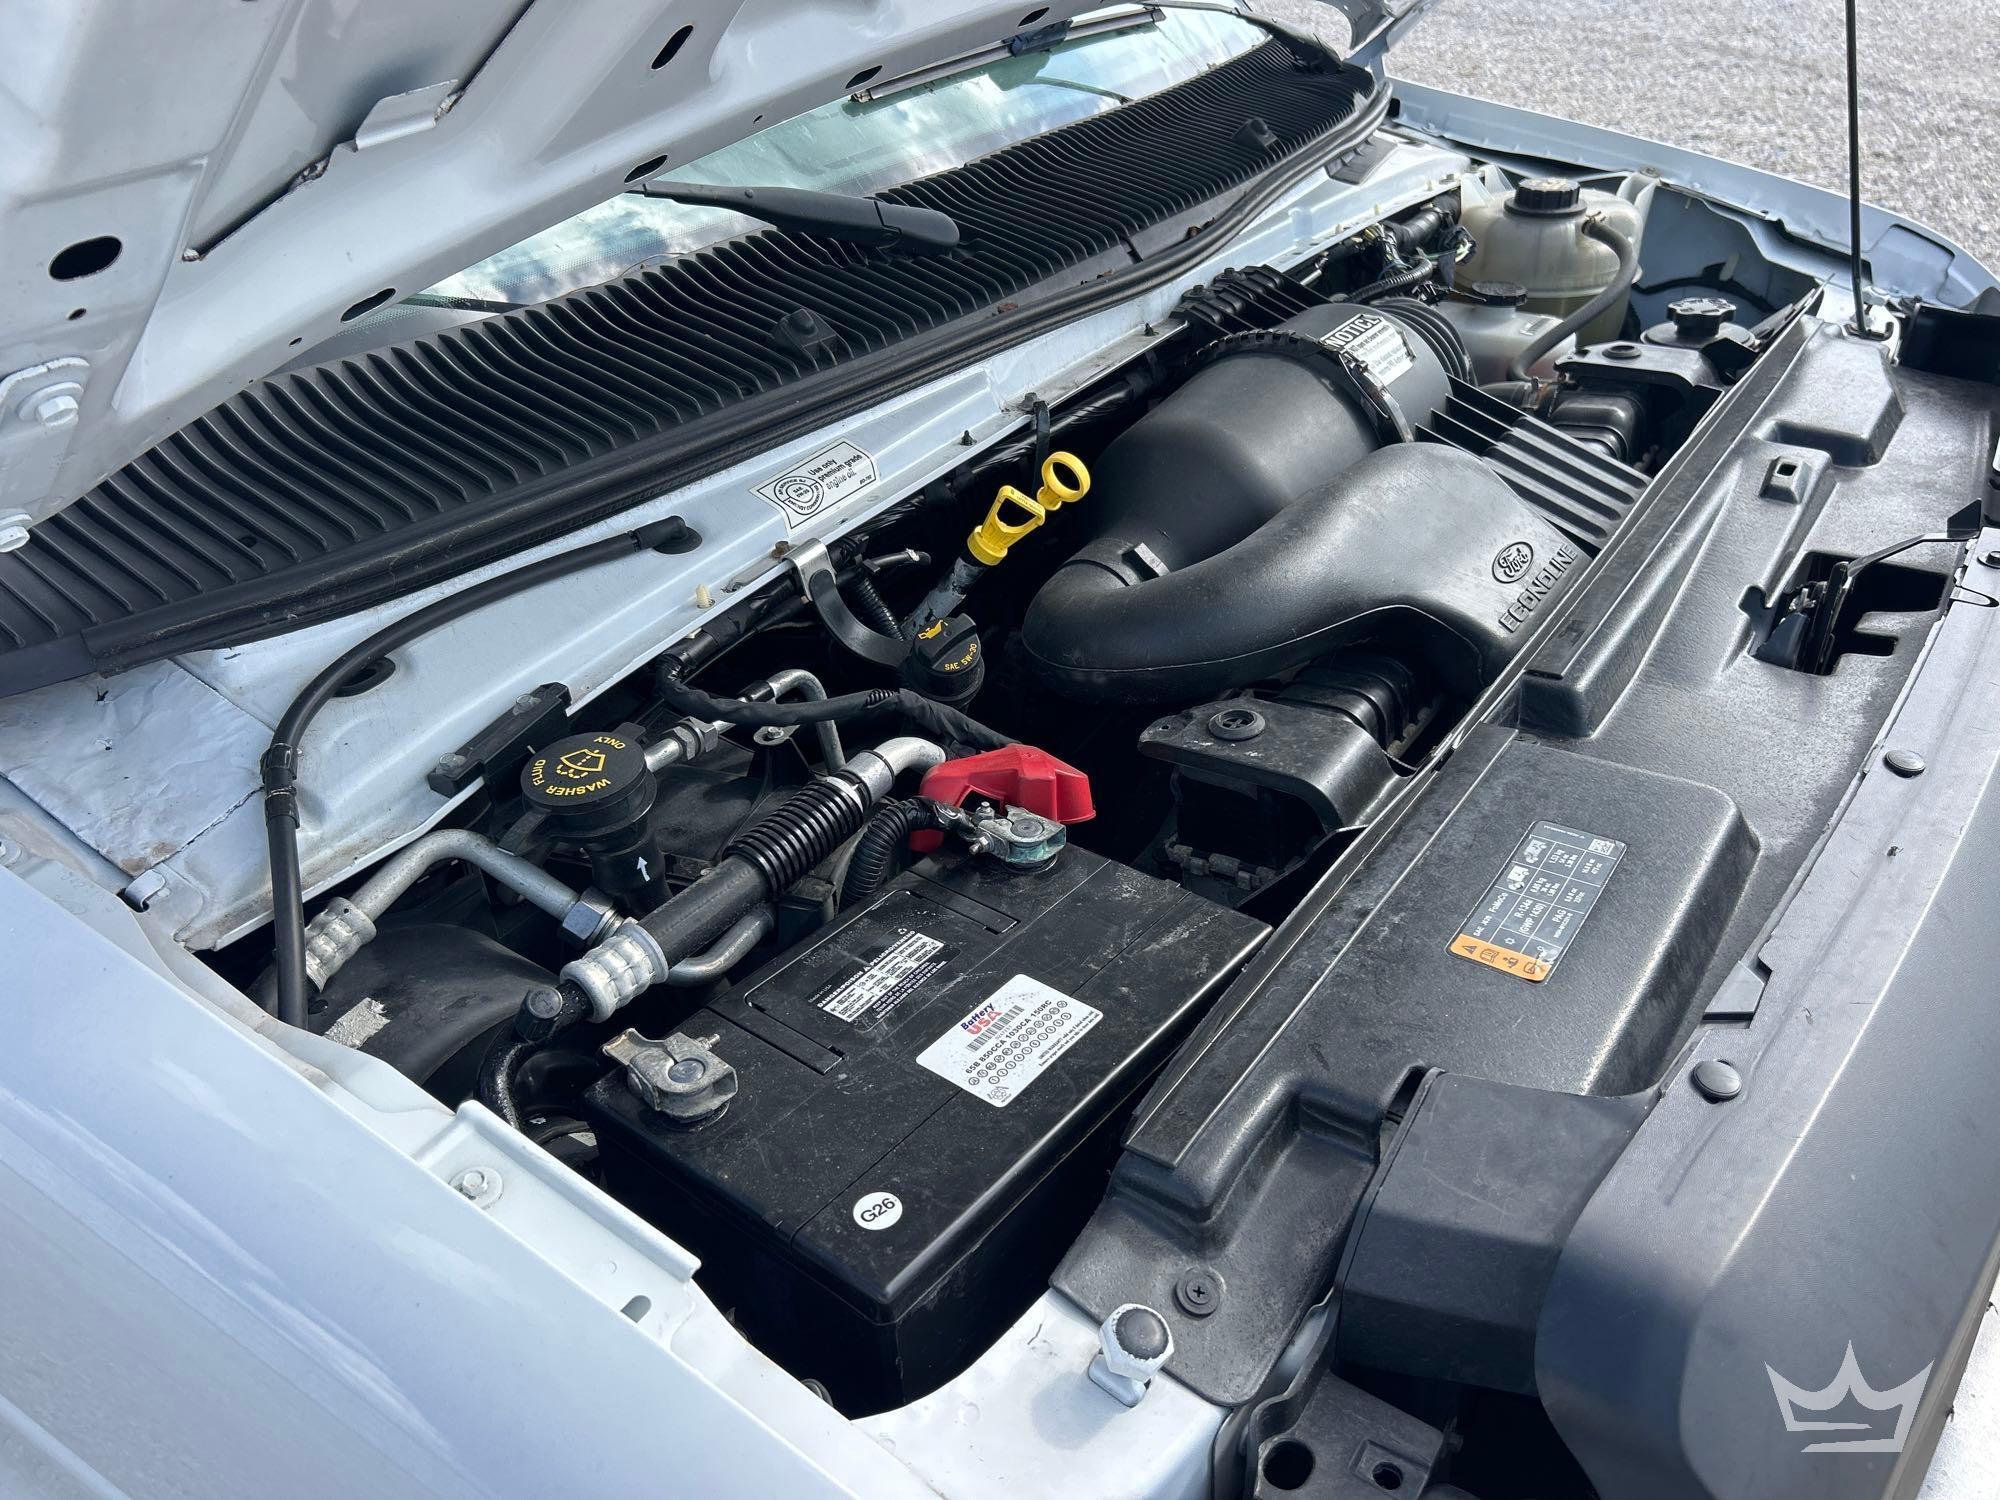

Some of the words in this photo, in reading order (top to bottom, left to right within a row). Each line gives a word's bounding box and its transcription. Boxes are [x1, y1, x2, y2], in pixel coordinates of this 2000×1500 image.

[808, 467, 823, 476] Use
[822, 459, 838, 469] only
[818, 464, 846, 482] premium
[844, 454, 863, 467] grade
[826, 476, 847, 490] engine
[1497, 546, 1529, 577] Ford
[1498, 544, 1577, 633] ECONOLINE
[943, 662, 960, 671] SAE
[960, 642, 977, 666] 5W-30
[593, 736, 626, 750] ONLY
[531, 758, 546, 786] FLUID
[545, 777, 611, 796] WASHER
[1473, 926, 1485, 937] SAE
[1488, 892, 1508, 913] FoMoCo
[1514, 899, 1533, 918] R-134a
[1552, 909, 1566, 923] PAG
[960, 1003, 995, 1031] Battery
[966, 1010, 1003, 1035] USA
[965, 1061, 981, 1074] 65B
[1006, 1018, 1031, 1039] 1030CA
[1030, 1000, 1052, 1017] 150RC
[860, 1198, 895, 1222] G26
